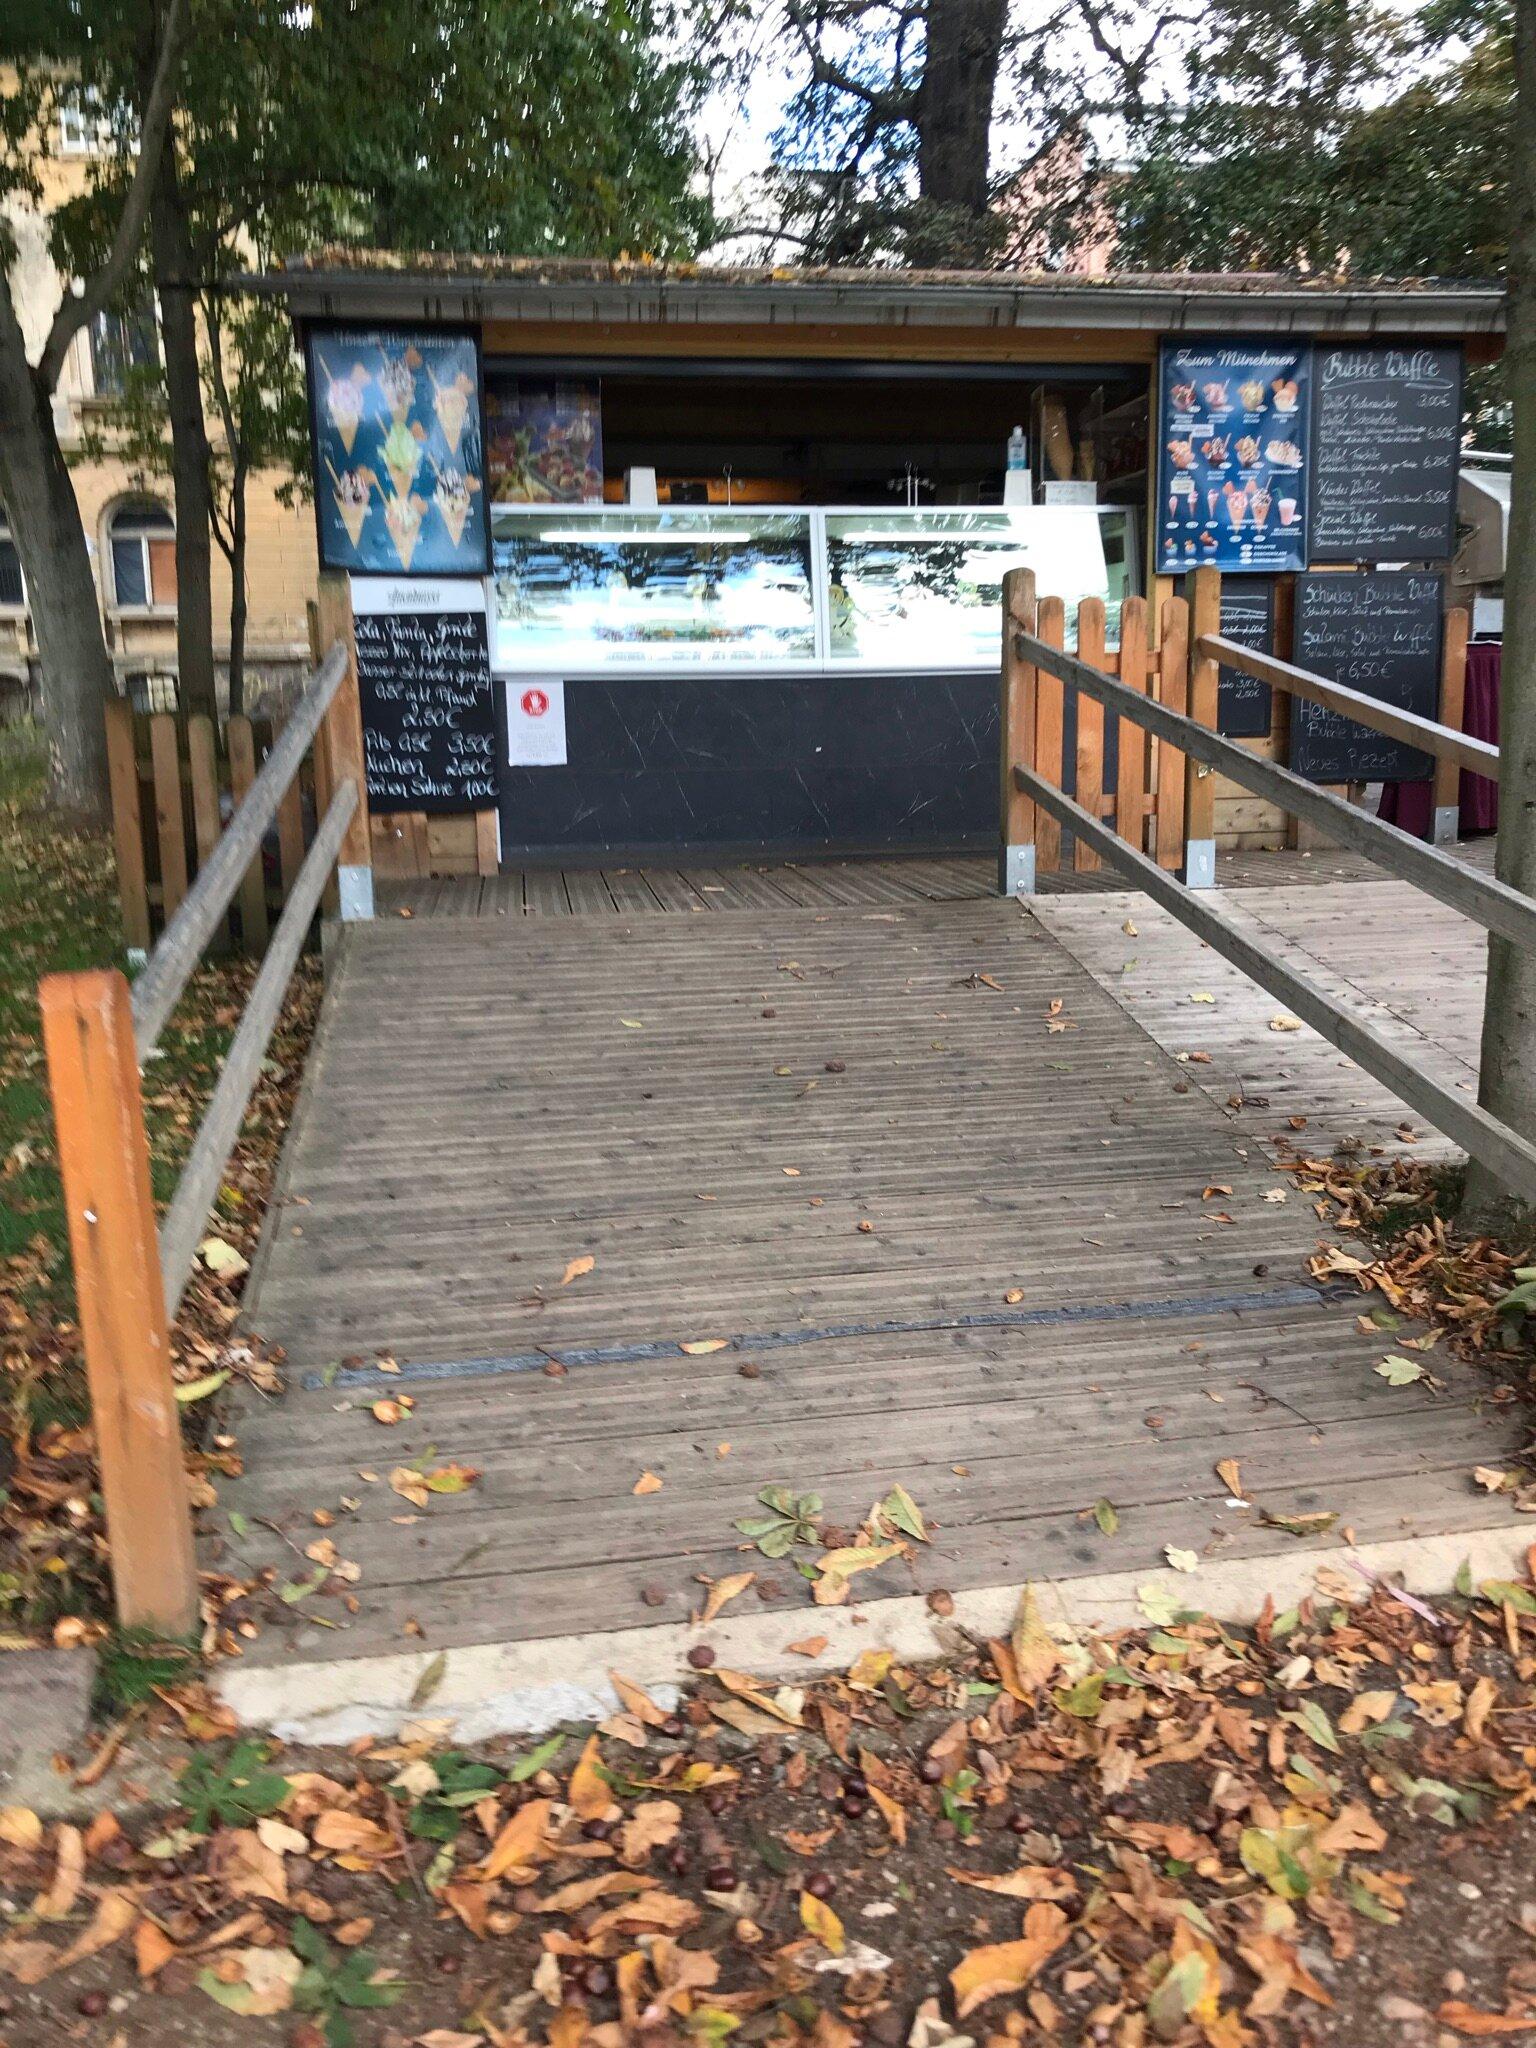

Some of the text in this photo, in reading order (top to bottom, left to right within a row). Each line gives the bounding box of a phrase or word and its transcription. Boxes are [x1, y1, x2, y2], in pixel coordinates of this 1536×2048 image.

[1175, 349, 1297, 367] Zum Mitnehmen
[1322, 352, 1380, 383] Bubble
[1348, 660, 1395, 680] 6,50€
